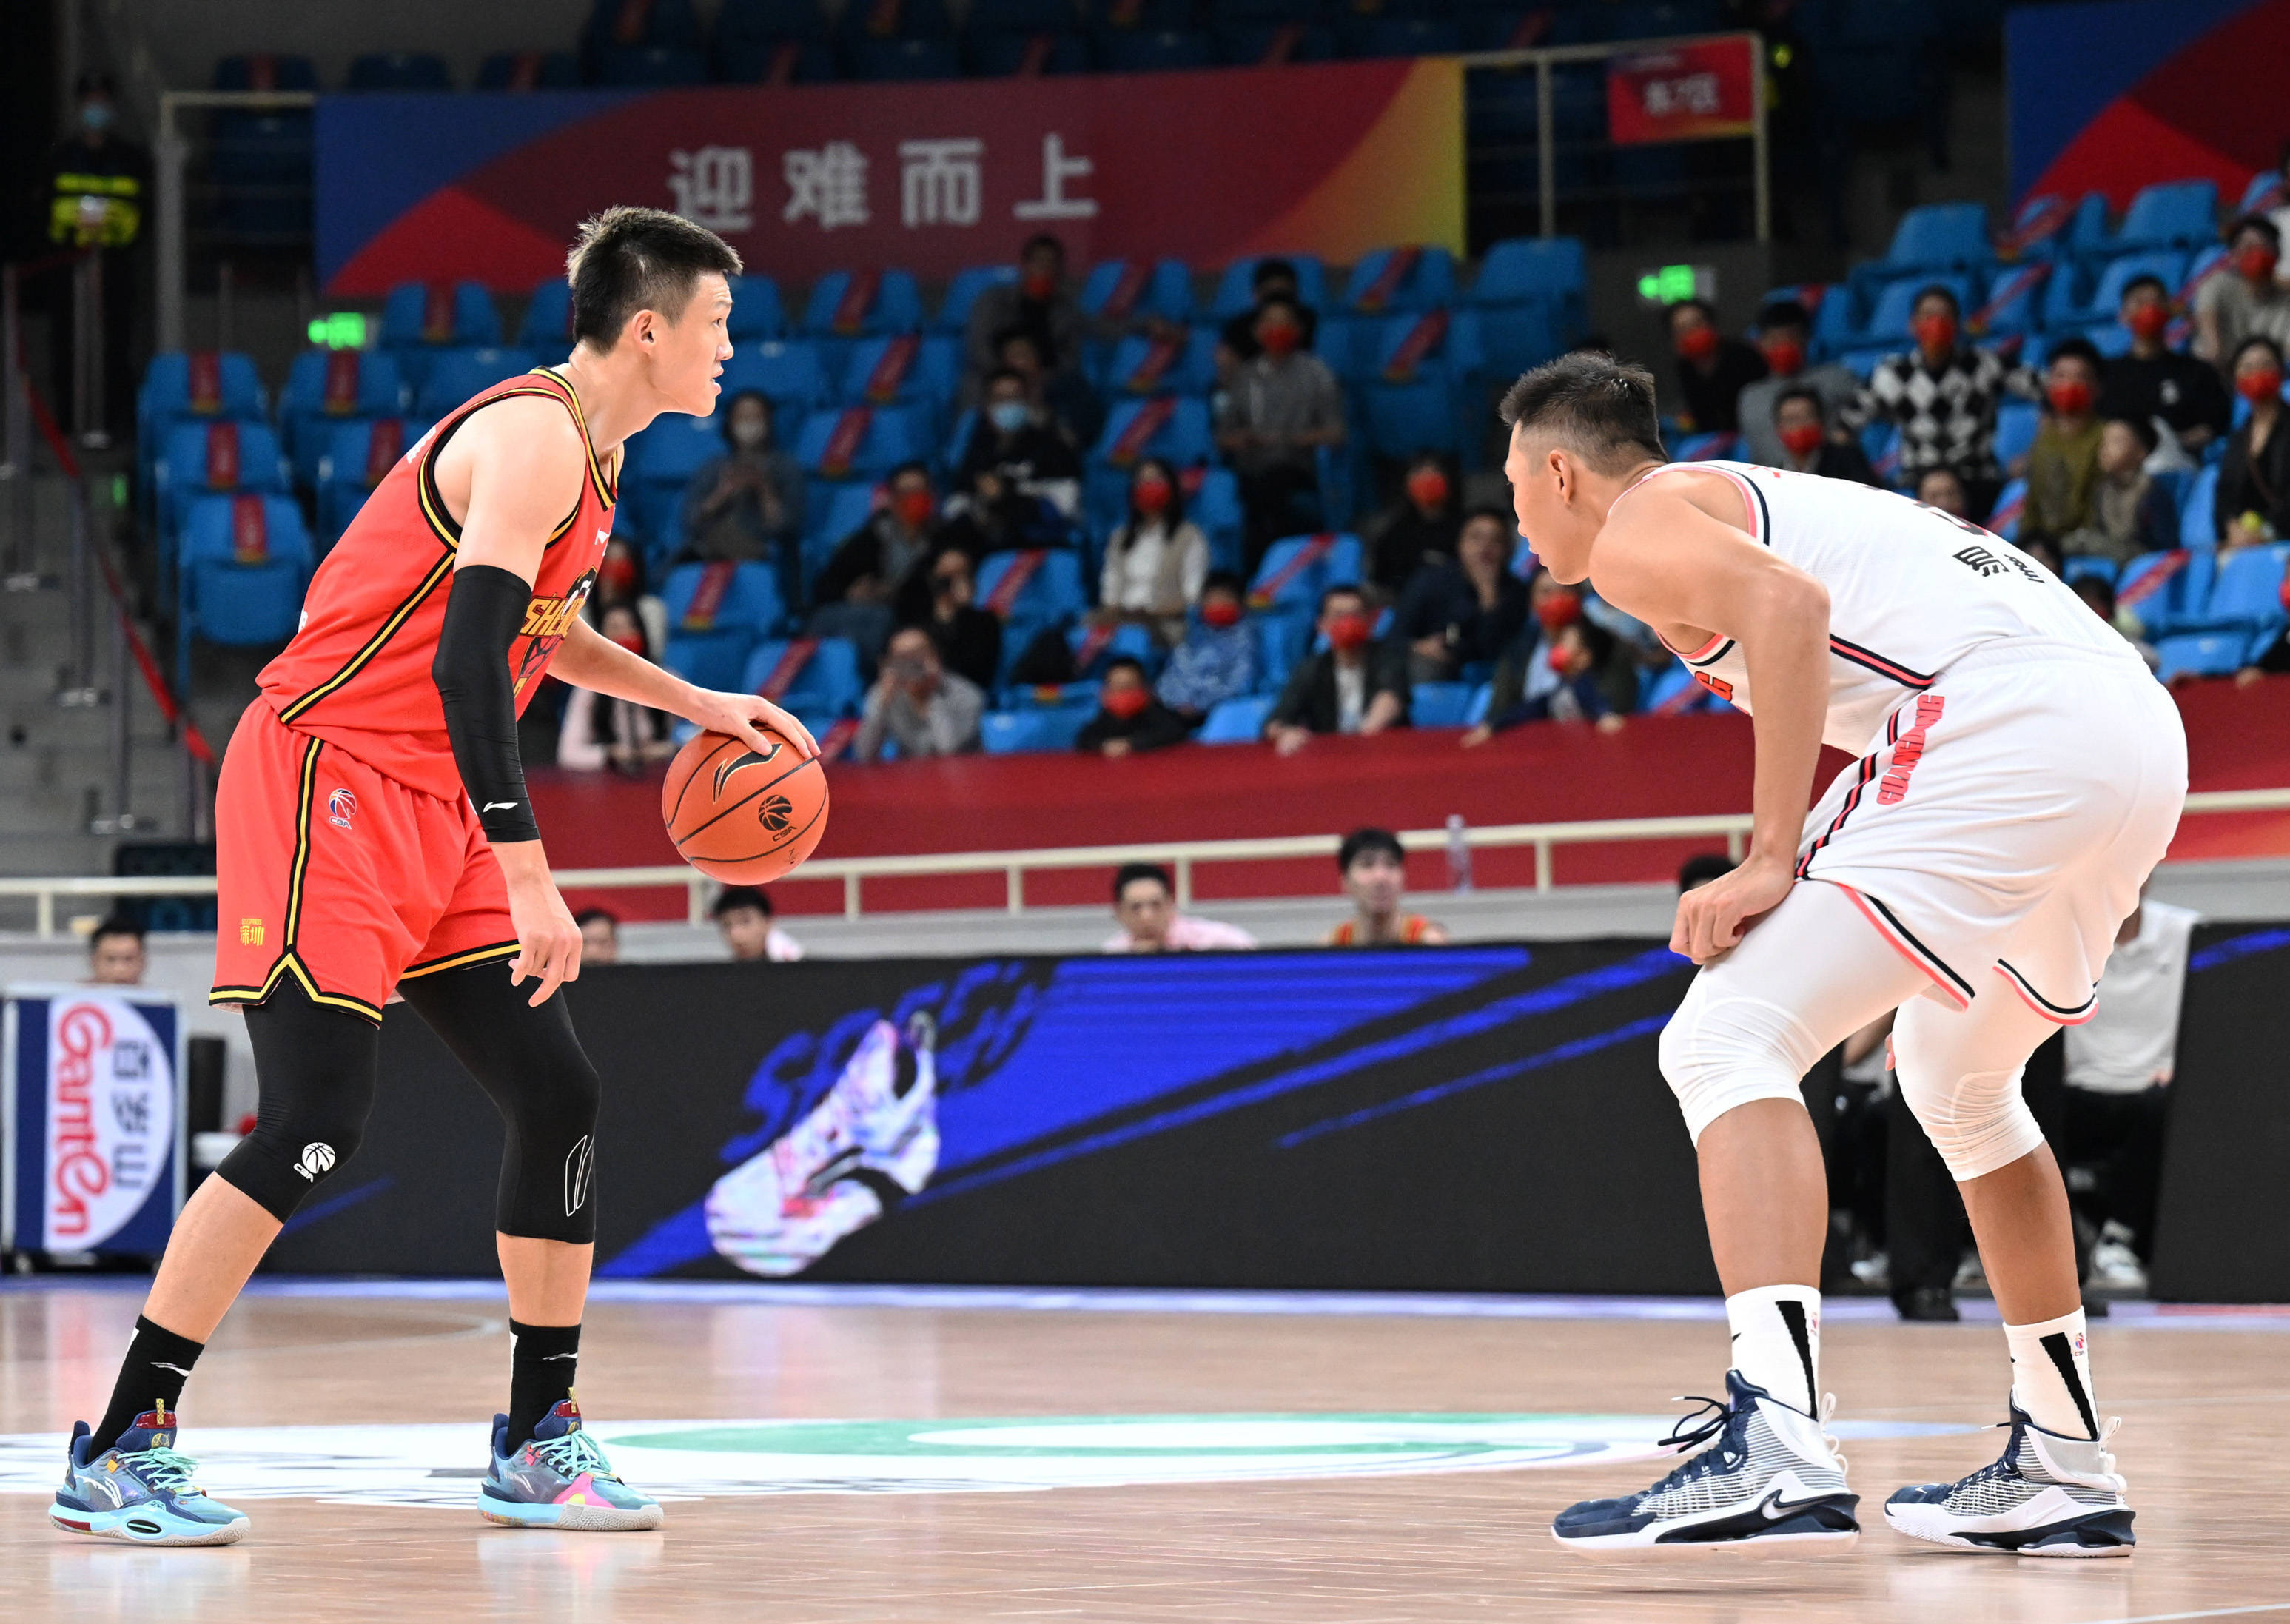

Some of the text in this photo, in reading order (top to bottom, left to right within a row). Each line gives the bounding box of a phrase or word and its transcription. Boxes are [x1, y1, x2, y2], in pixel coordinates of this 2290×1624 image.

[668, 132, 1098, 231] 迎难而上
[239, 925, 265, 947] 深圳
[113, 1038, 150, 1190] 百岁山
